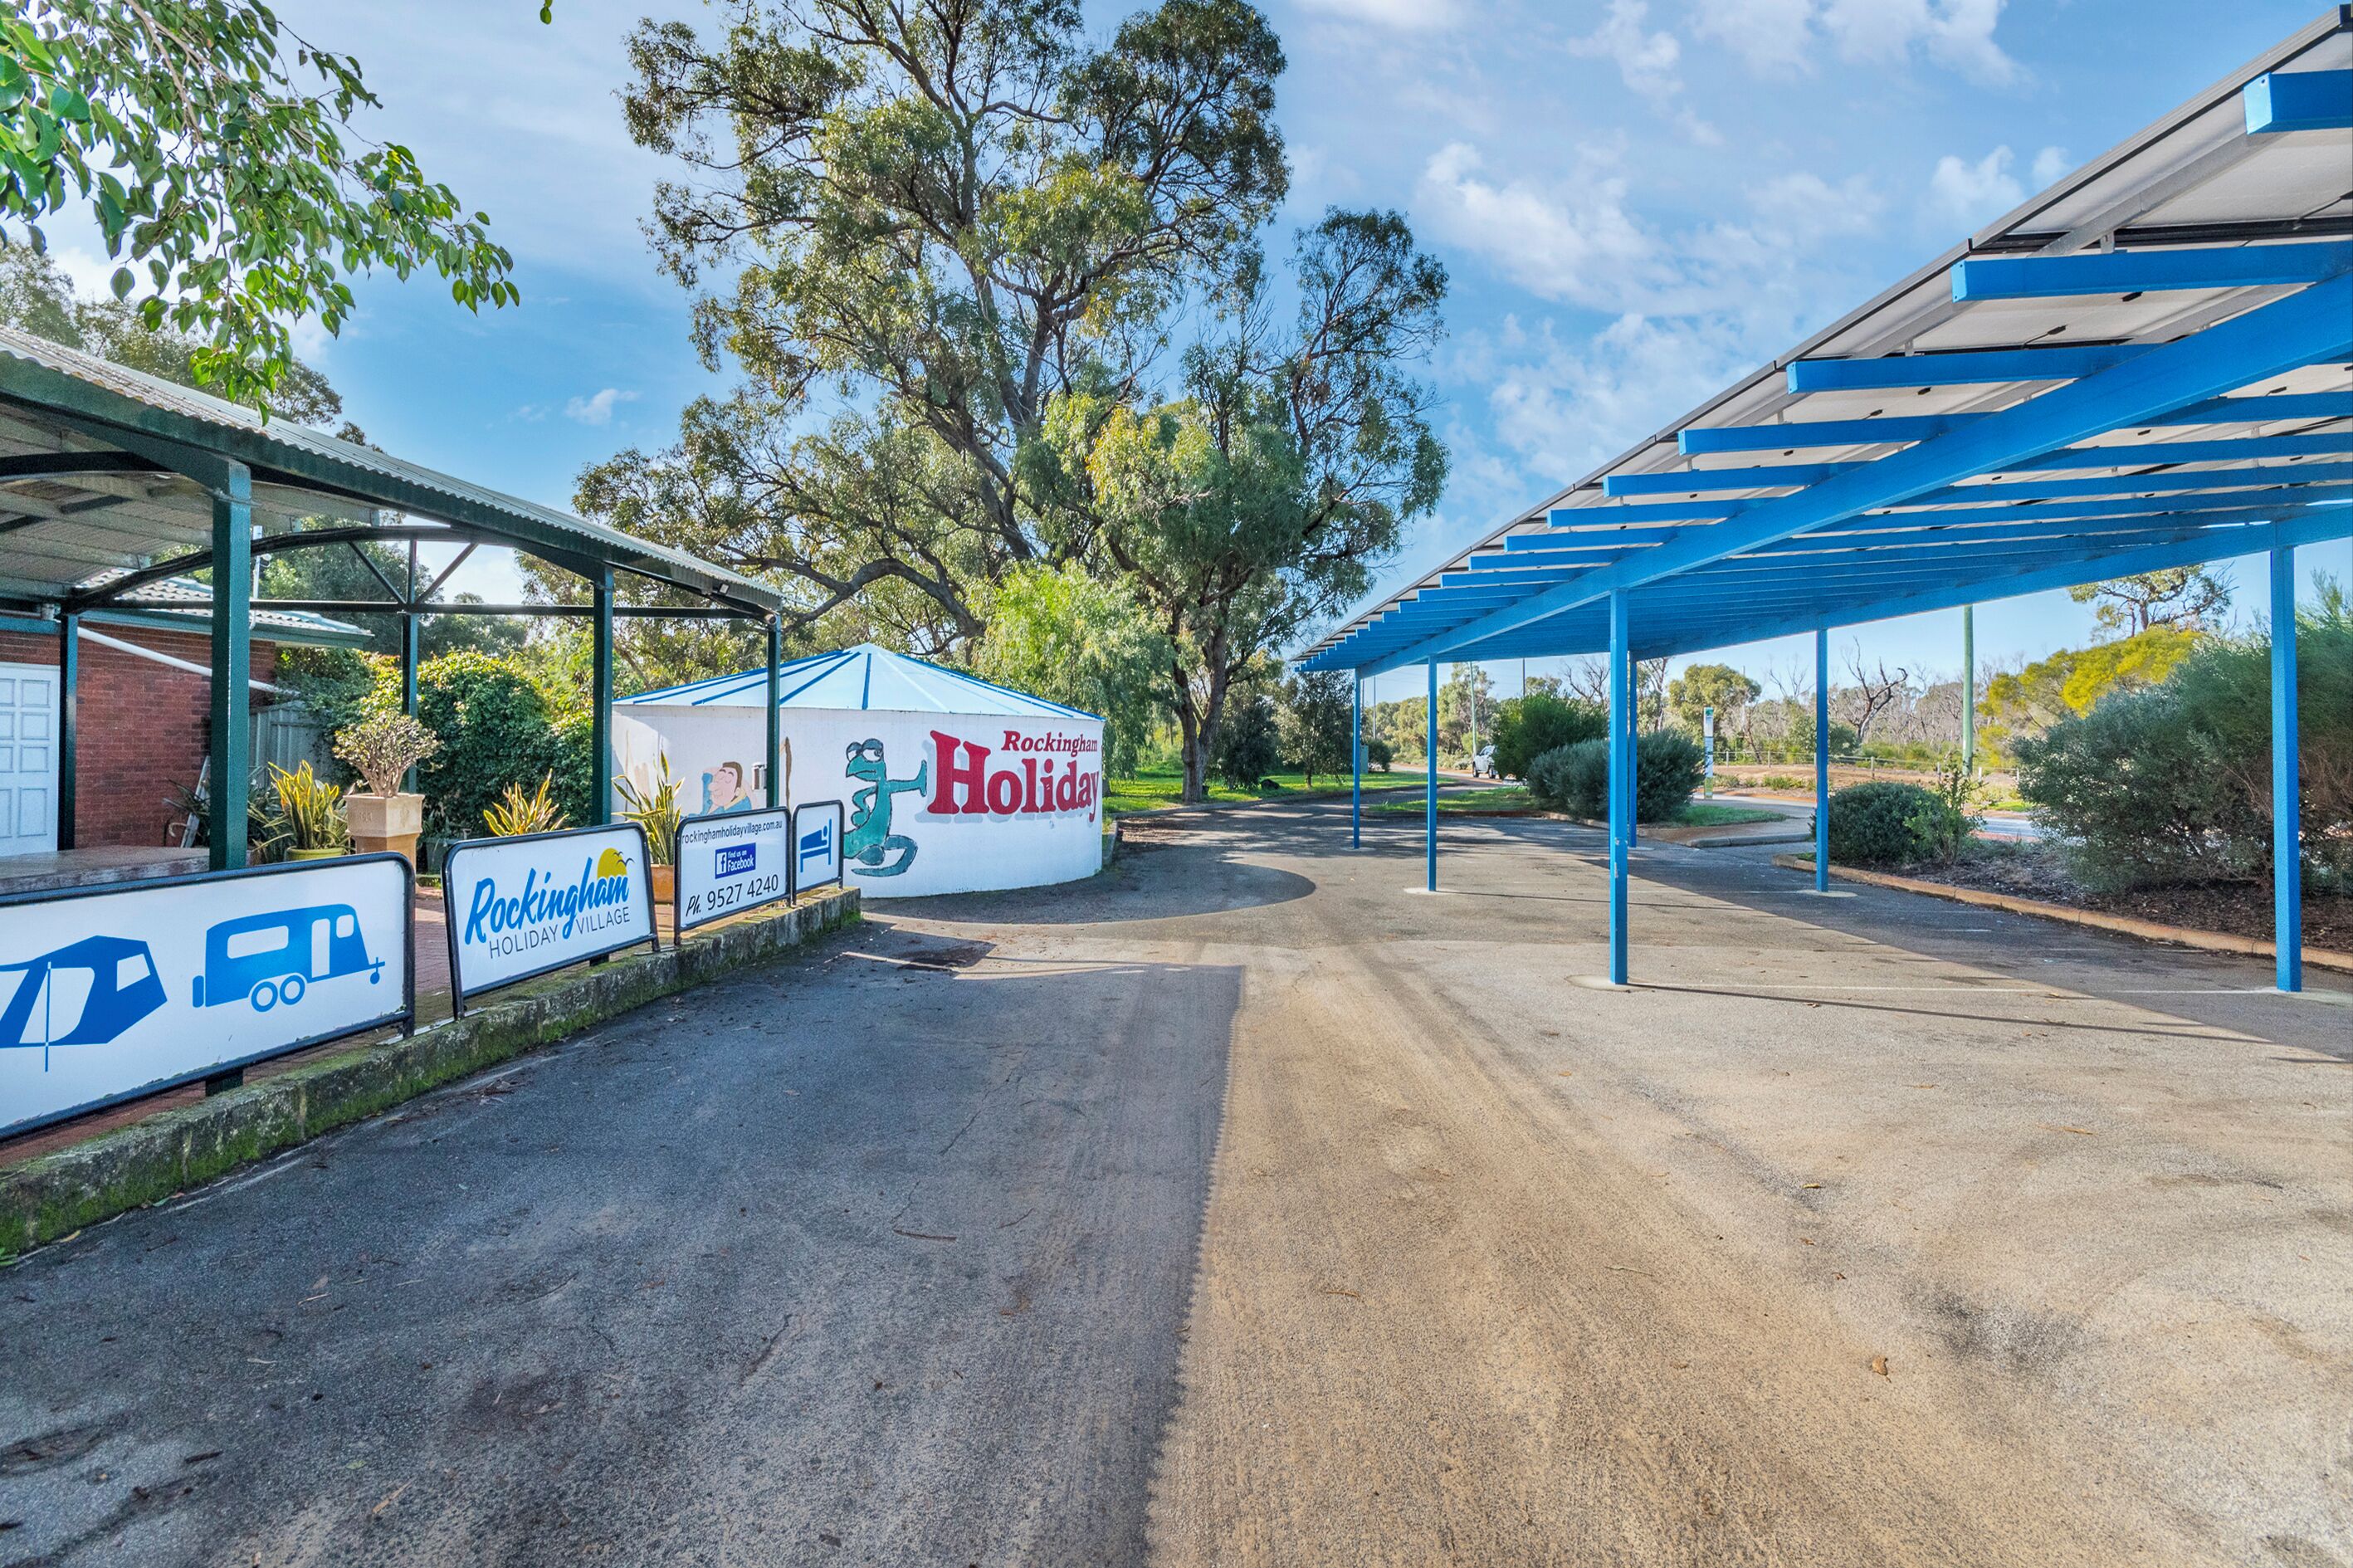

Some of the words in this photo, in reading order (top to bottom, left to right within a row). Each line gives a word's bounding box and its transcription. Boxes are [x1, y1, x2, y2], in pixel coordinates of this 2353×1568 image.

[1001, 730, 1098, 757] Rockingham
[927, 730, 1100, 823] Holiday
[681, 820, 783, 844] rockinghamholidayvillage.com.au
[727, 855, 754, 872] Facebook
[464, 857, 630, 945] Rockingham
[686, 894, 701, 917] Ph.
[707, 883, 743, 911] 9527
[747, 874, 779, 898] 4240
[489, 924, 559, 959] HOLIDAY
[575, 906, 631, 934] VILLAGE
